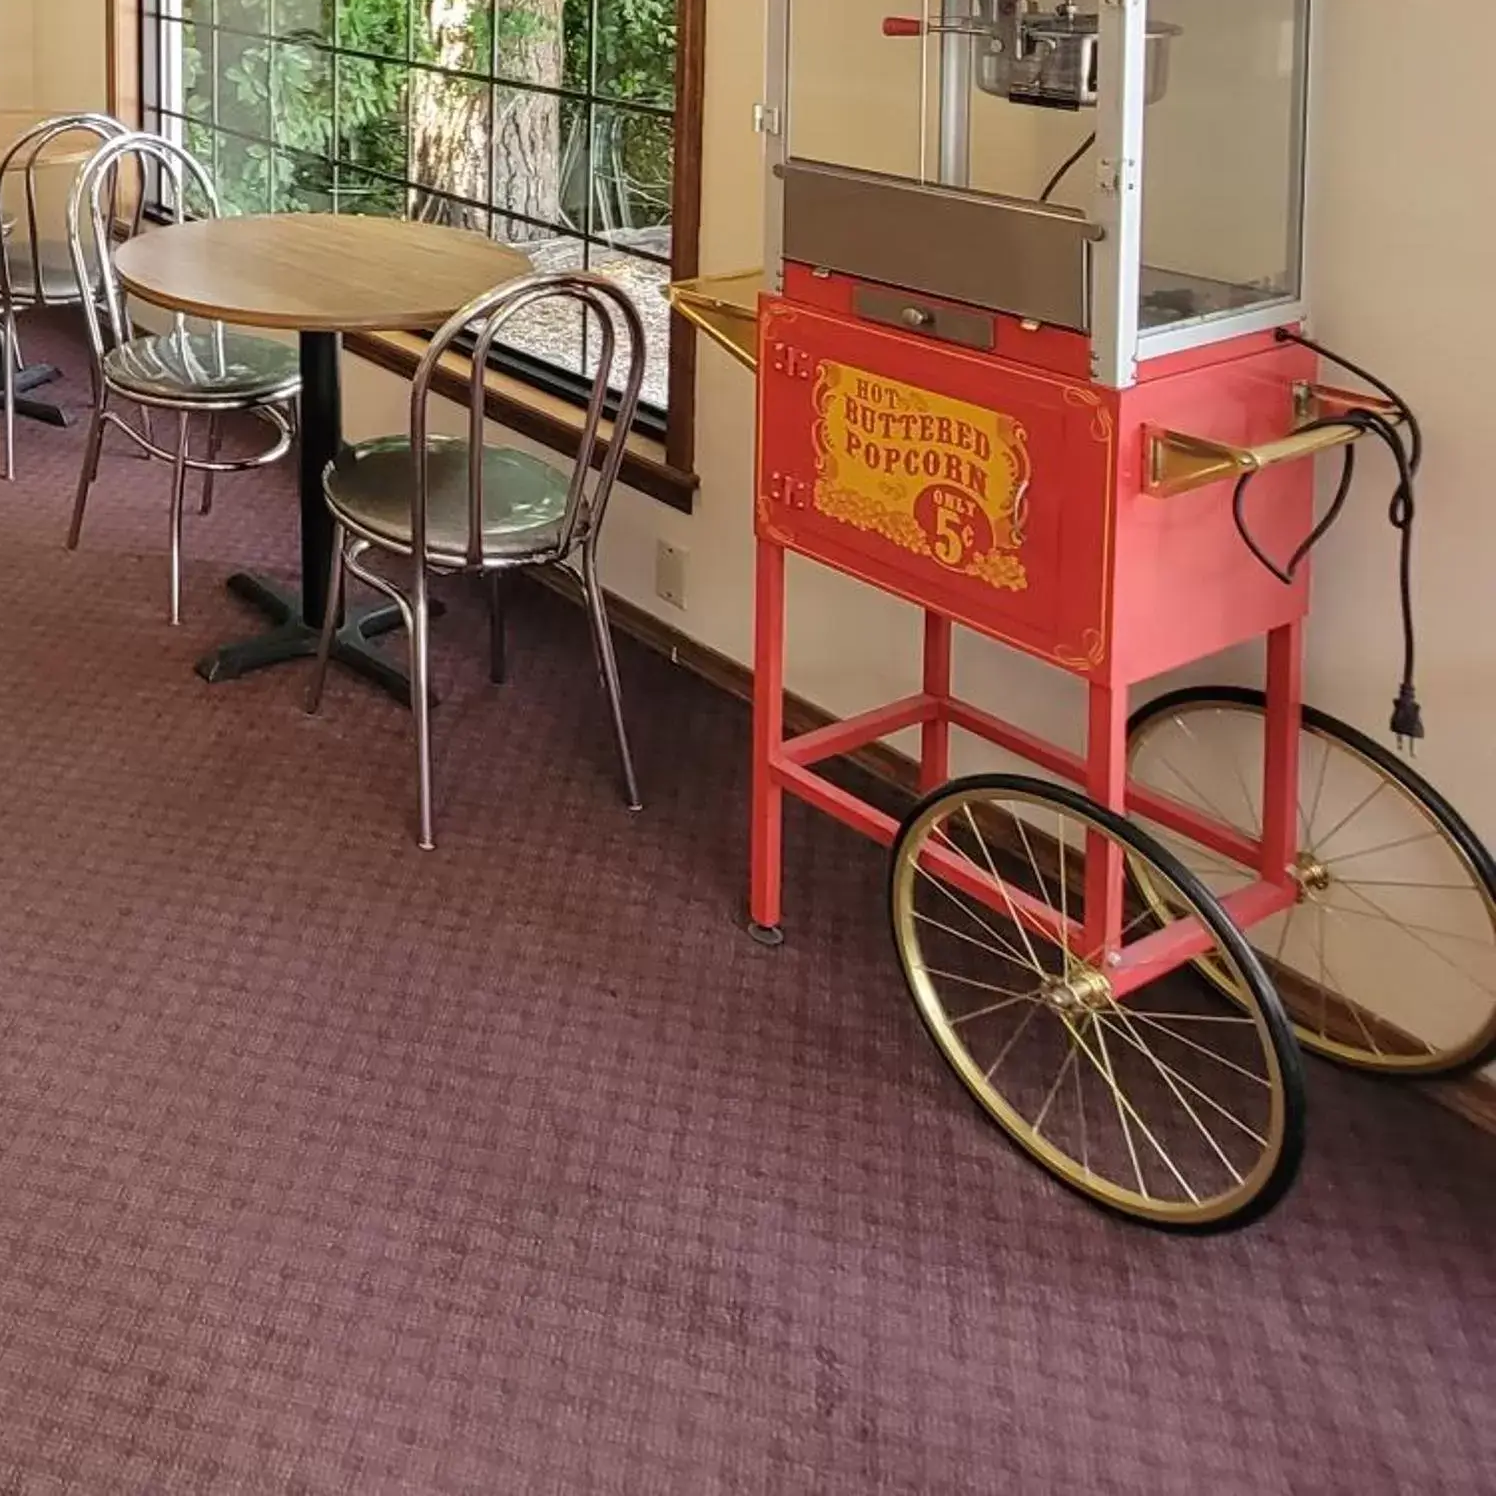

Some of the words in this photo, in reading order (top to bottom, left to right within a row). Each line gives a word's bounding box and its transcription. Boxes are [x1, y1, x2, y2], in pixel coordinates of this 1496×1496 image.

[856, 377, 901, 410] HOT
[844, 393, 992, 463] BUTTERED
[845, 429, 990, 502] POPCORN
[932, 488, 977, 519] ONLY
